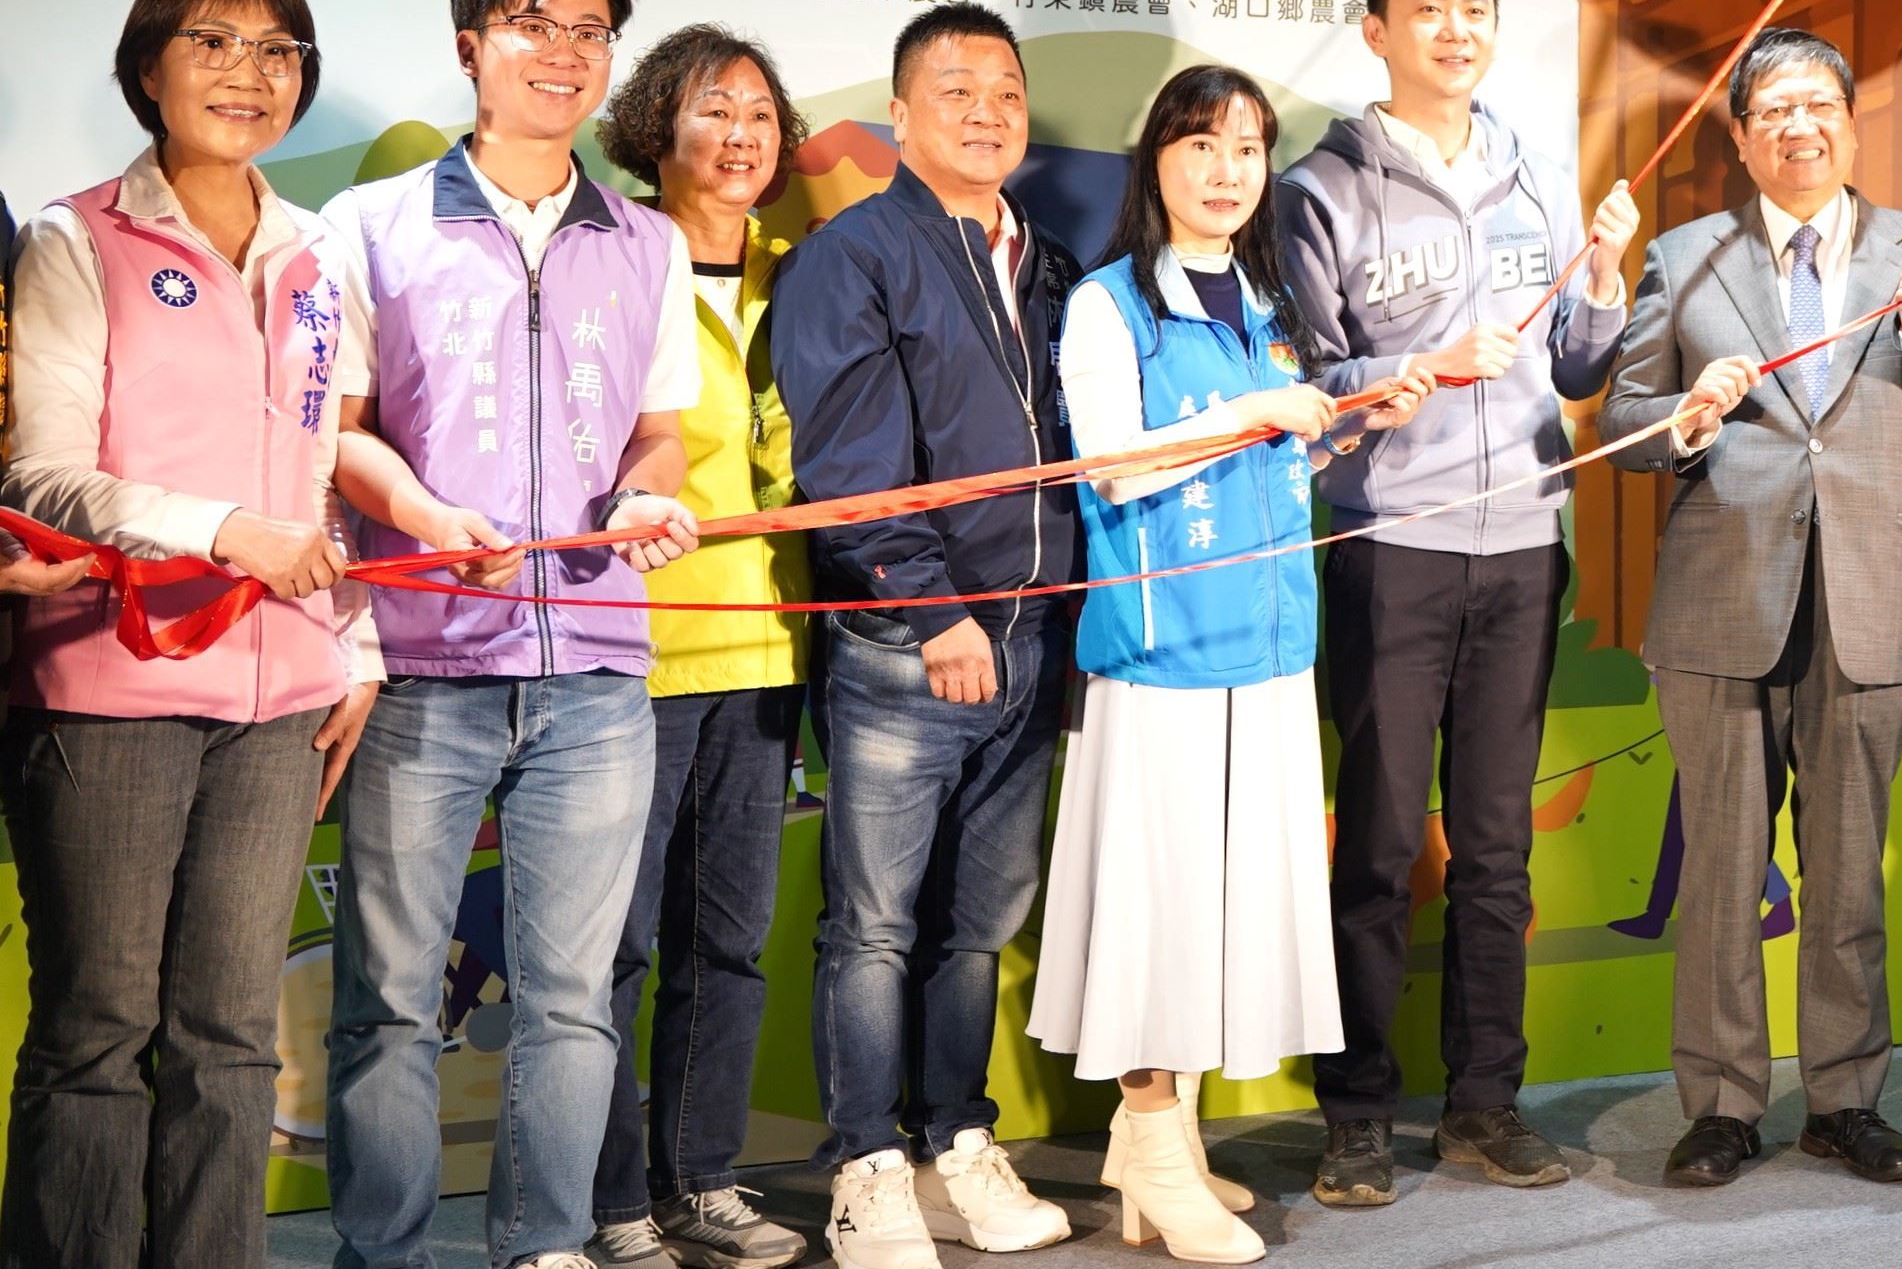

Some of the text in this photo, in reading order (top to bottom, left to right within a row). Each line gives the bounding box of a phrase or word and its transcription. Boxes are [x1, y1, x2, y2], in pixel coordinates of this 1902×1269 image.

[438, 299, 467, 357] 竹北
[1364, 235, 1459, 307] ZHU
[468, 296, 499, 454] 新竹縣議員
[565, 307, 607, 464] 林禹佑
